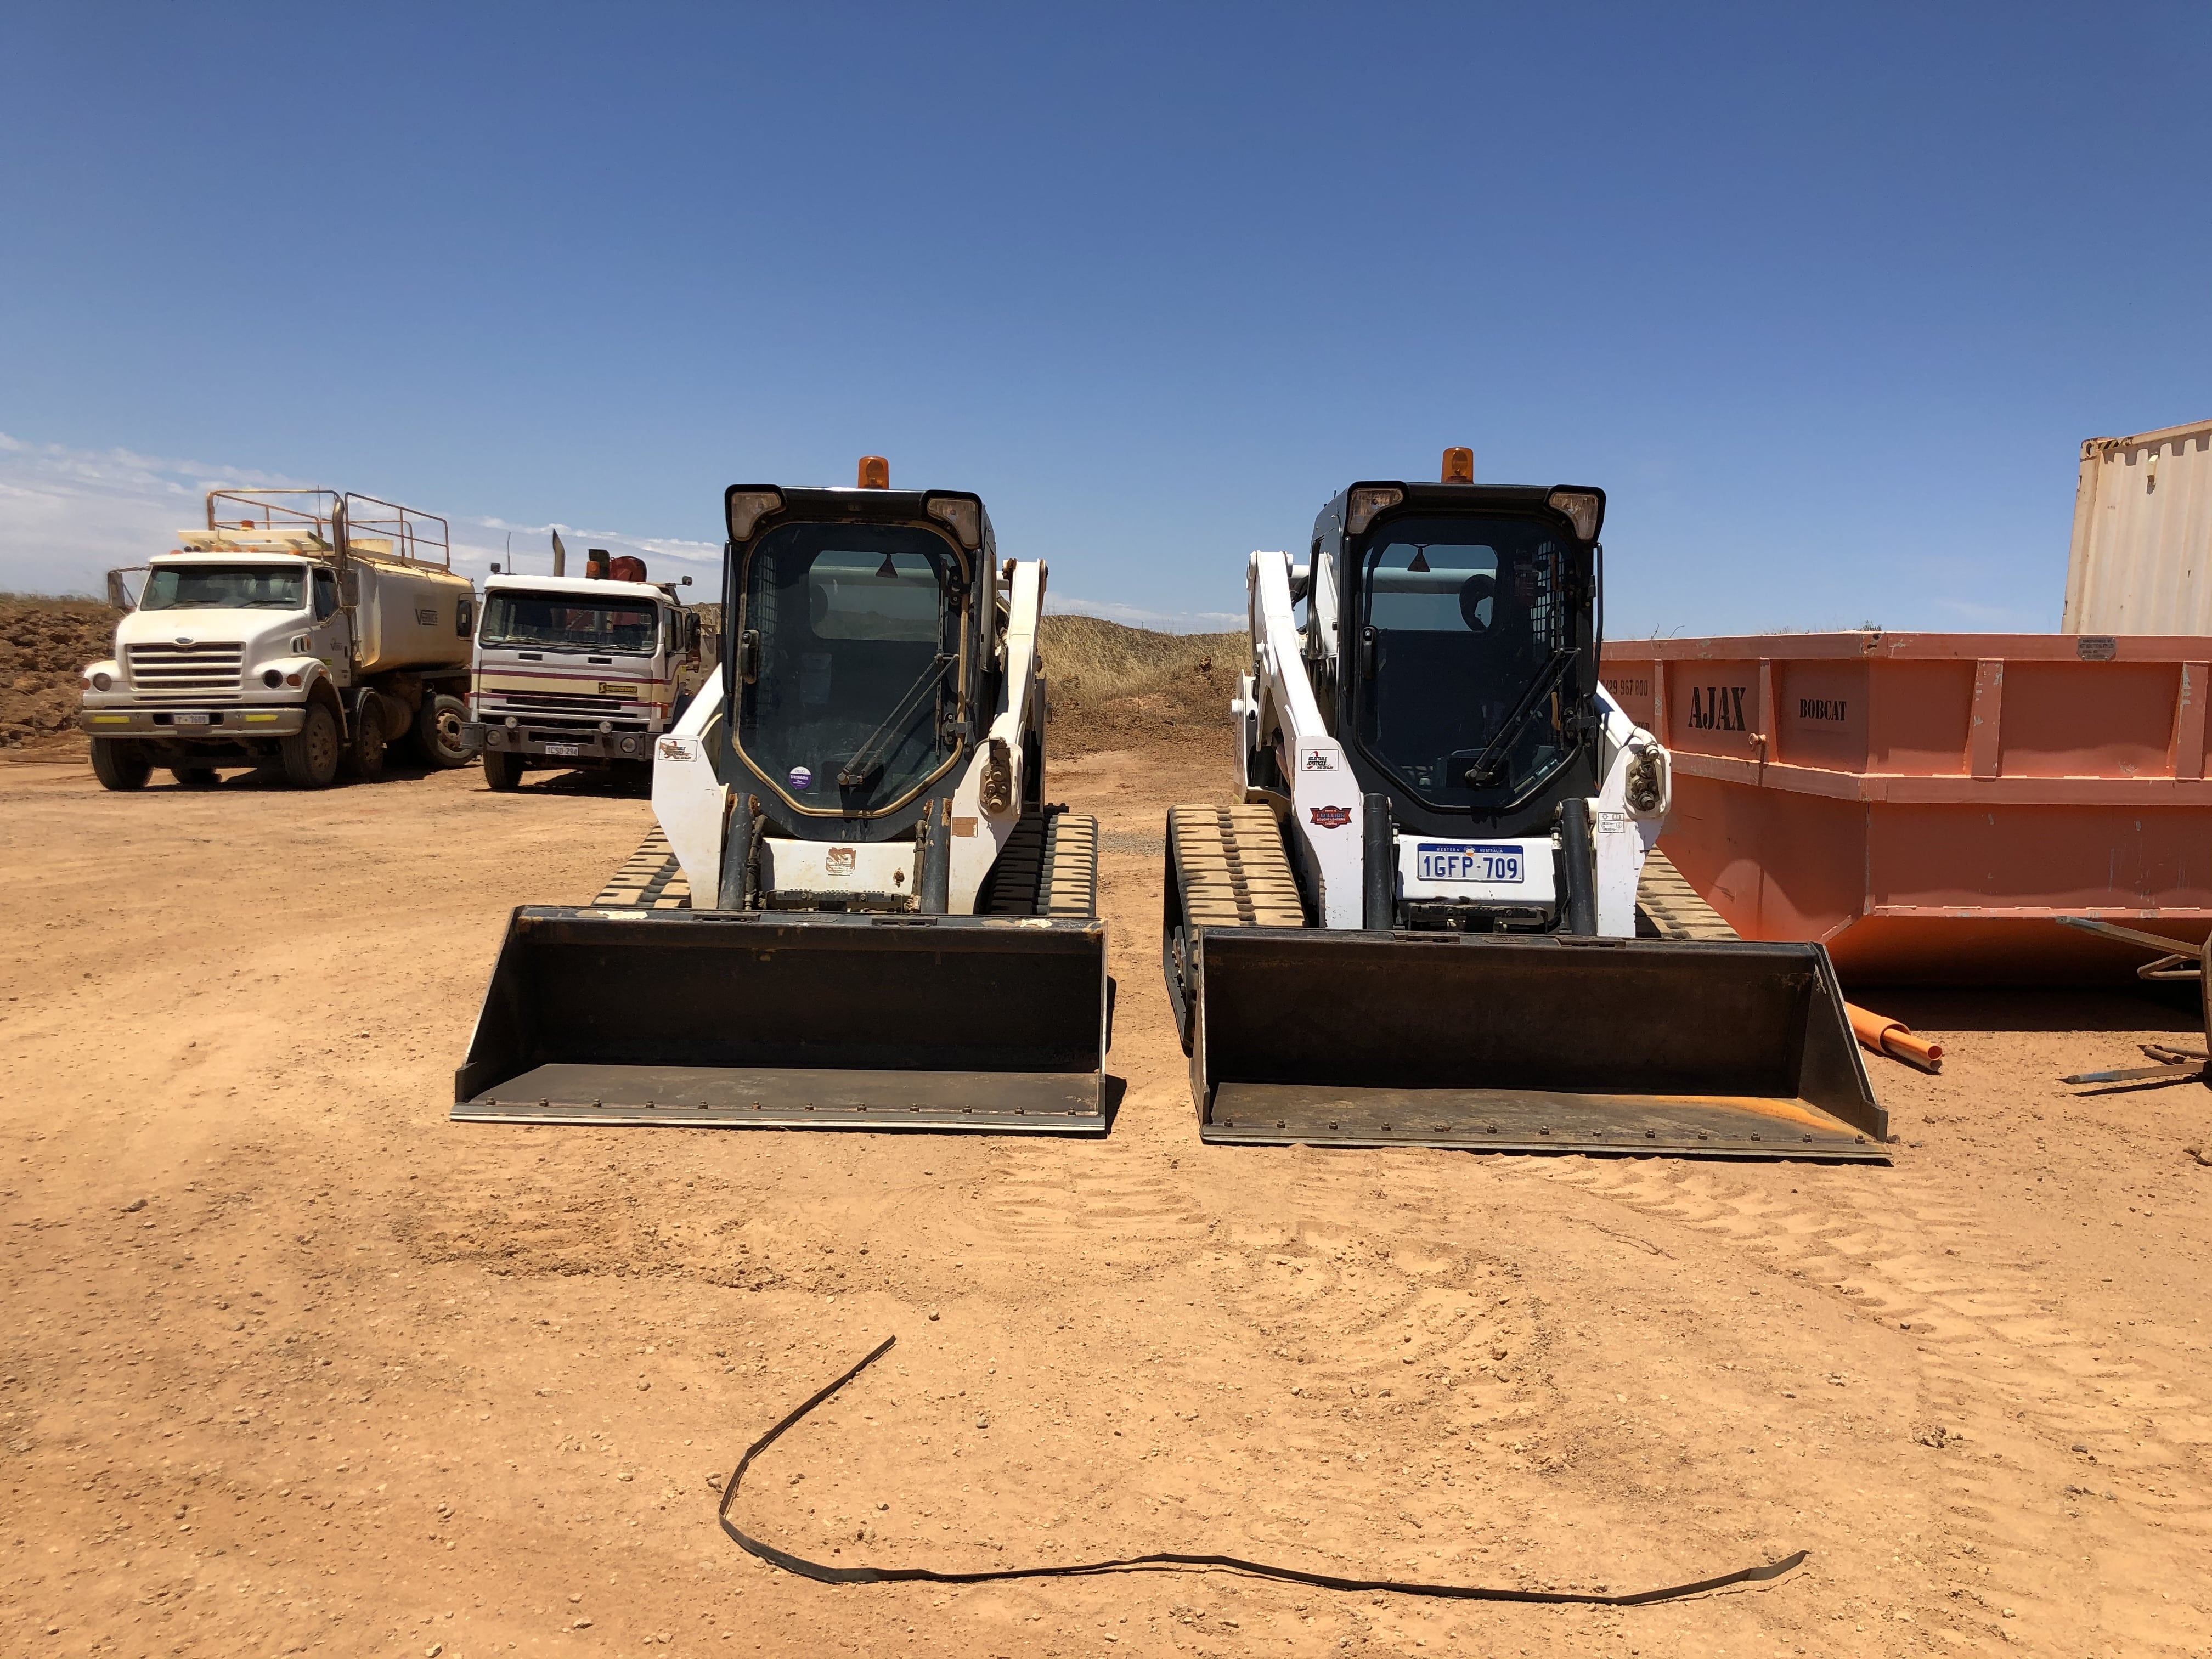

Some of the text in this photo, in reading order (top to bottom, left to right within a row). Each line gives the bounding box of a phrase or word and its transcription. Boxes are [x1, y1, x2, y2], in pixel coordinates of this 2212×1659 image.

[1621, 680, 1633, 696] 967
[1635, 680, 1648, 697] 800
[1688, 687, 1746, 731] AJAX
[1799, 698, 1847, 721] BOBCAT
[1424, 855, 1517, 879] 1GFP 709
